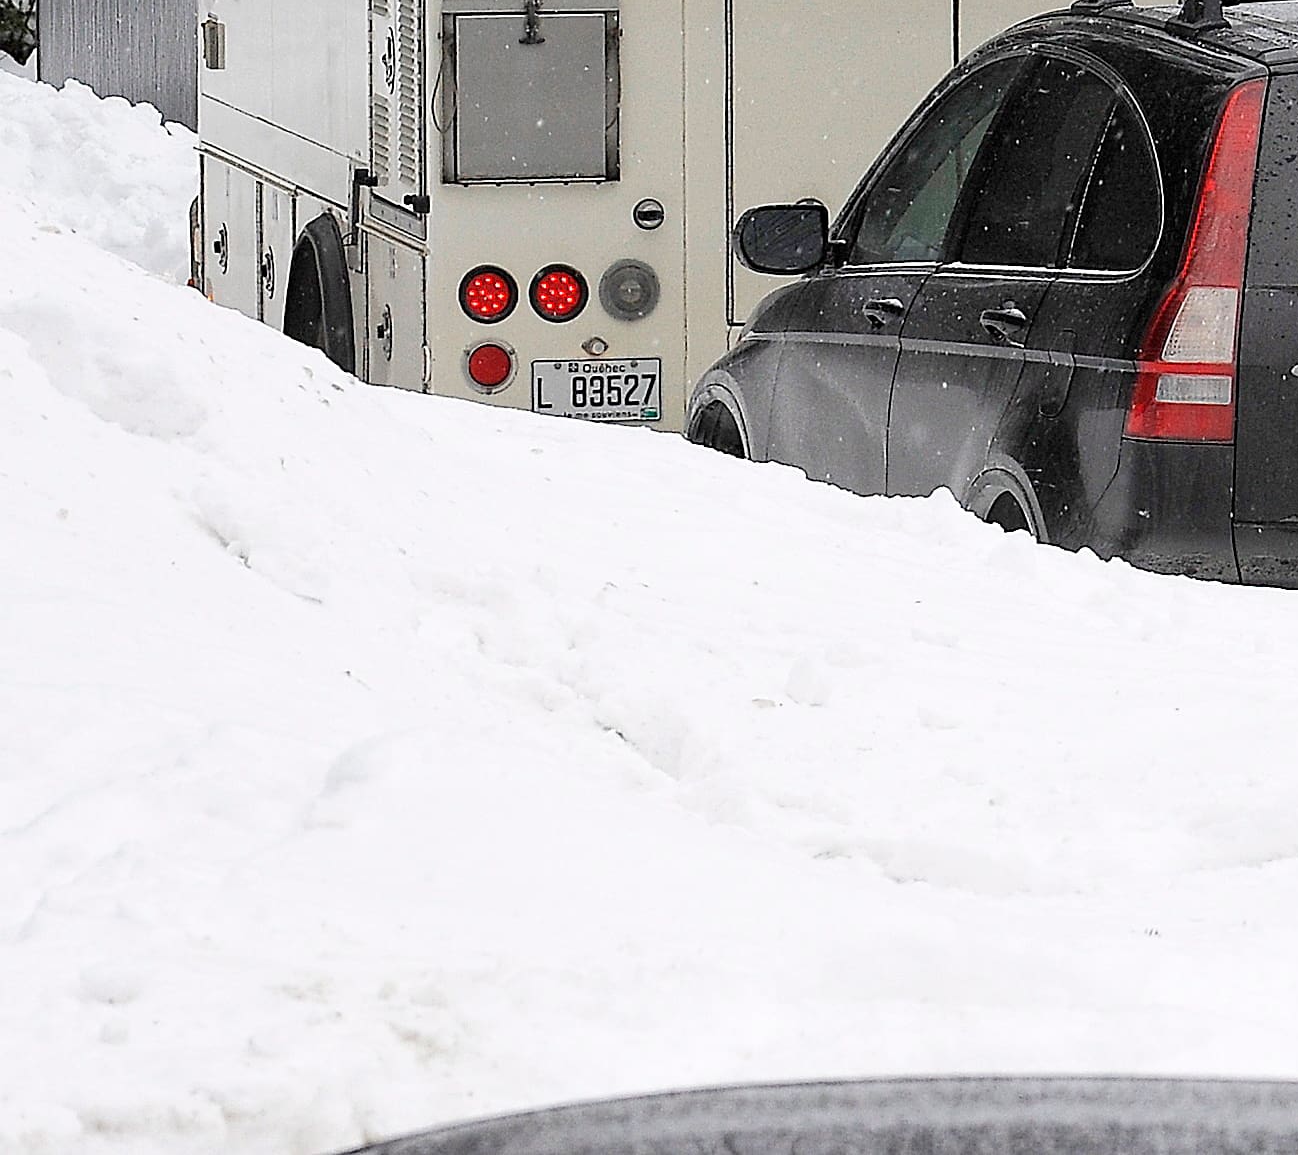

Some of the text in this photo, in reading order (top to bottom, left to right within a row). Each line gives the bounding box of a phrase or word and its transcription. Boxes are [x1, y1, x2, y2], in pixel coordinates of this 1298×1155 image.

[583, 362, 626, 373] Québec
[537, 373, 657, 409] L 83527
